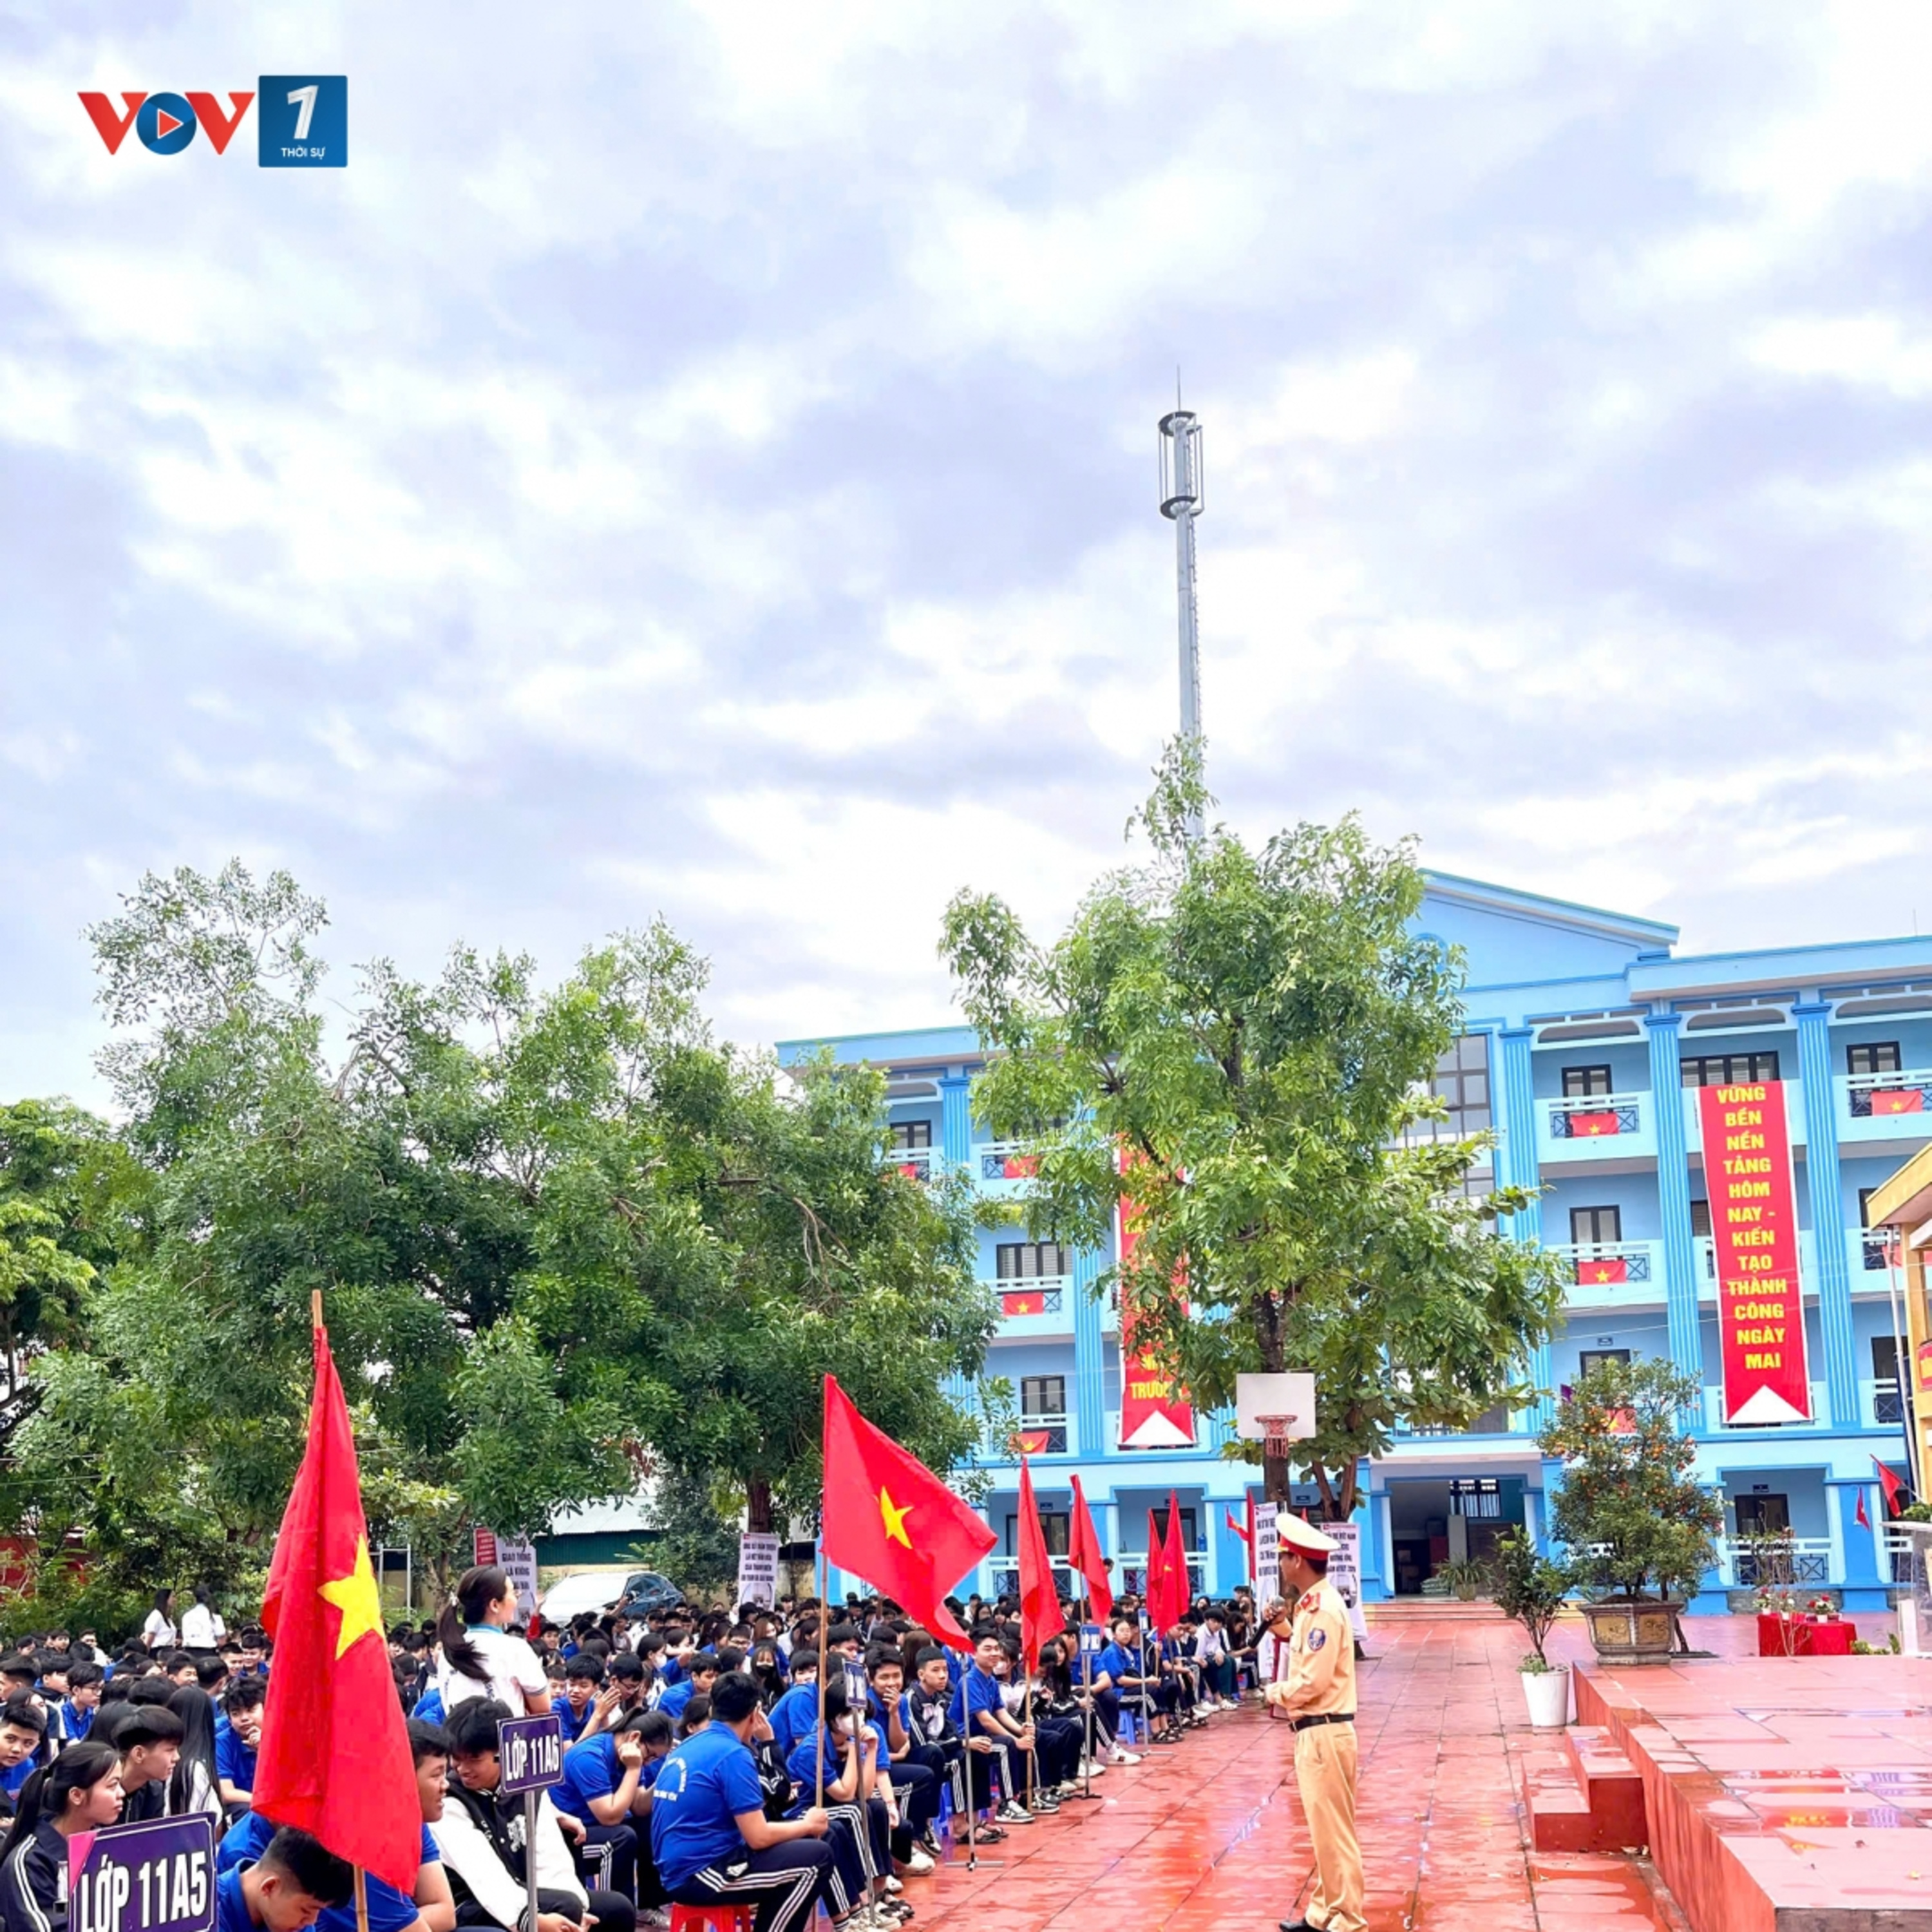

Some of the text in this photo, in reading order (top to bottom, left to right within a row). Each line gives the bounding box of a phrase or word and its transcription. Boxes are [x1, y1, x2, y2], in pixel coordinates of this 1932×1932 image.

[1723, 1155, 1772, 1174] TẢNG
[1728, 1180, 1770, 1198] HÔM
[1727, 1207, 1762, 1222] NAY
[1732, 1226, 1774, 1247] KIẾN
[1737, 1255, 1772, 1274] TẠO
[1727, 1276, 1787, 1296] THÀNH
[1734, 1302, 1785, 1320] CÔNG
[1736, 1326, 1785, 1345] NGÀY
[1745, 1352, 1781, 1369] MAI
[505, 1732, 560, 1781] LỚP 11A6
[81, 1850, 207, 1932] LỚP 11A5
